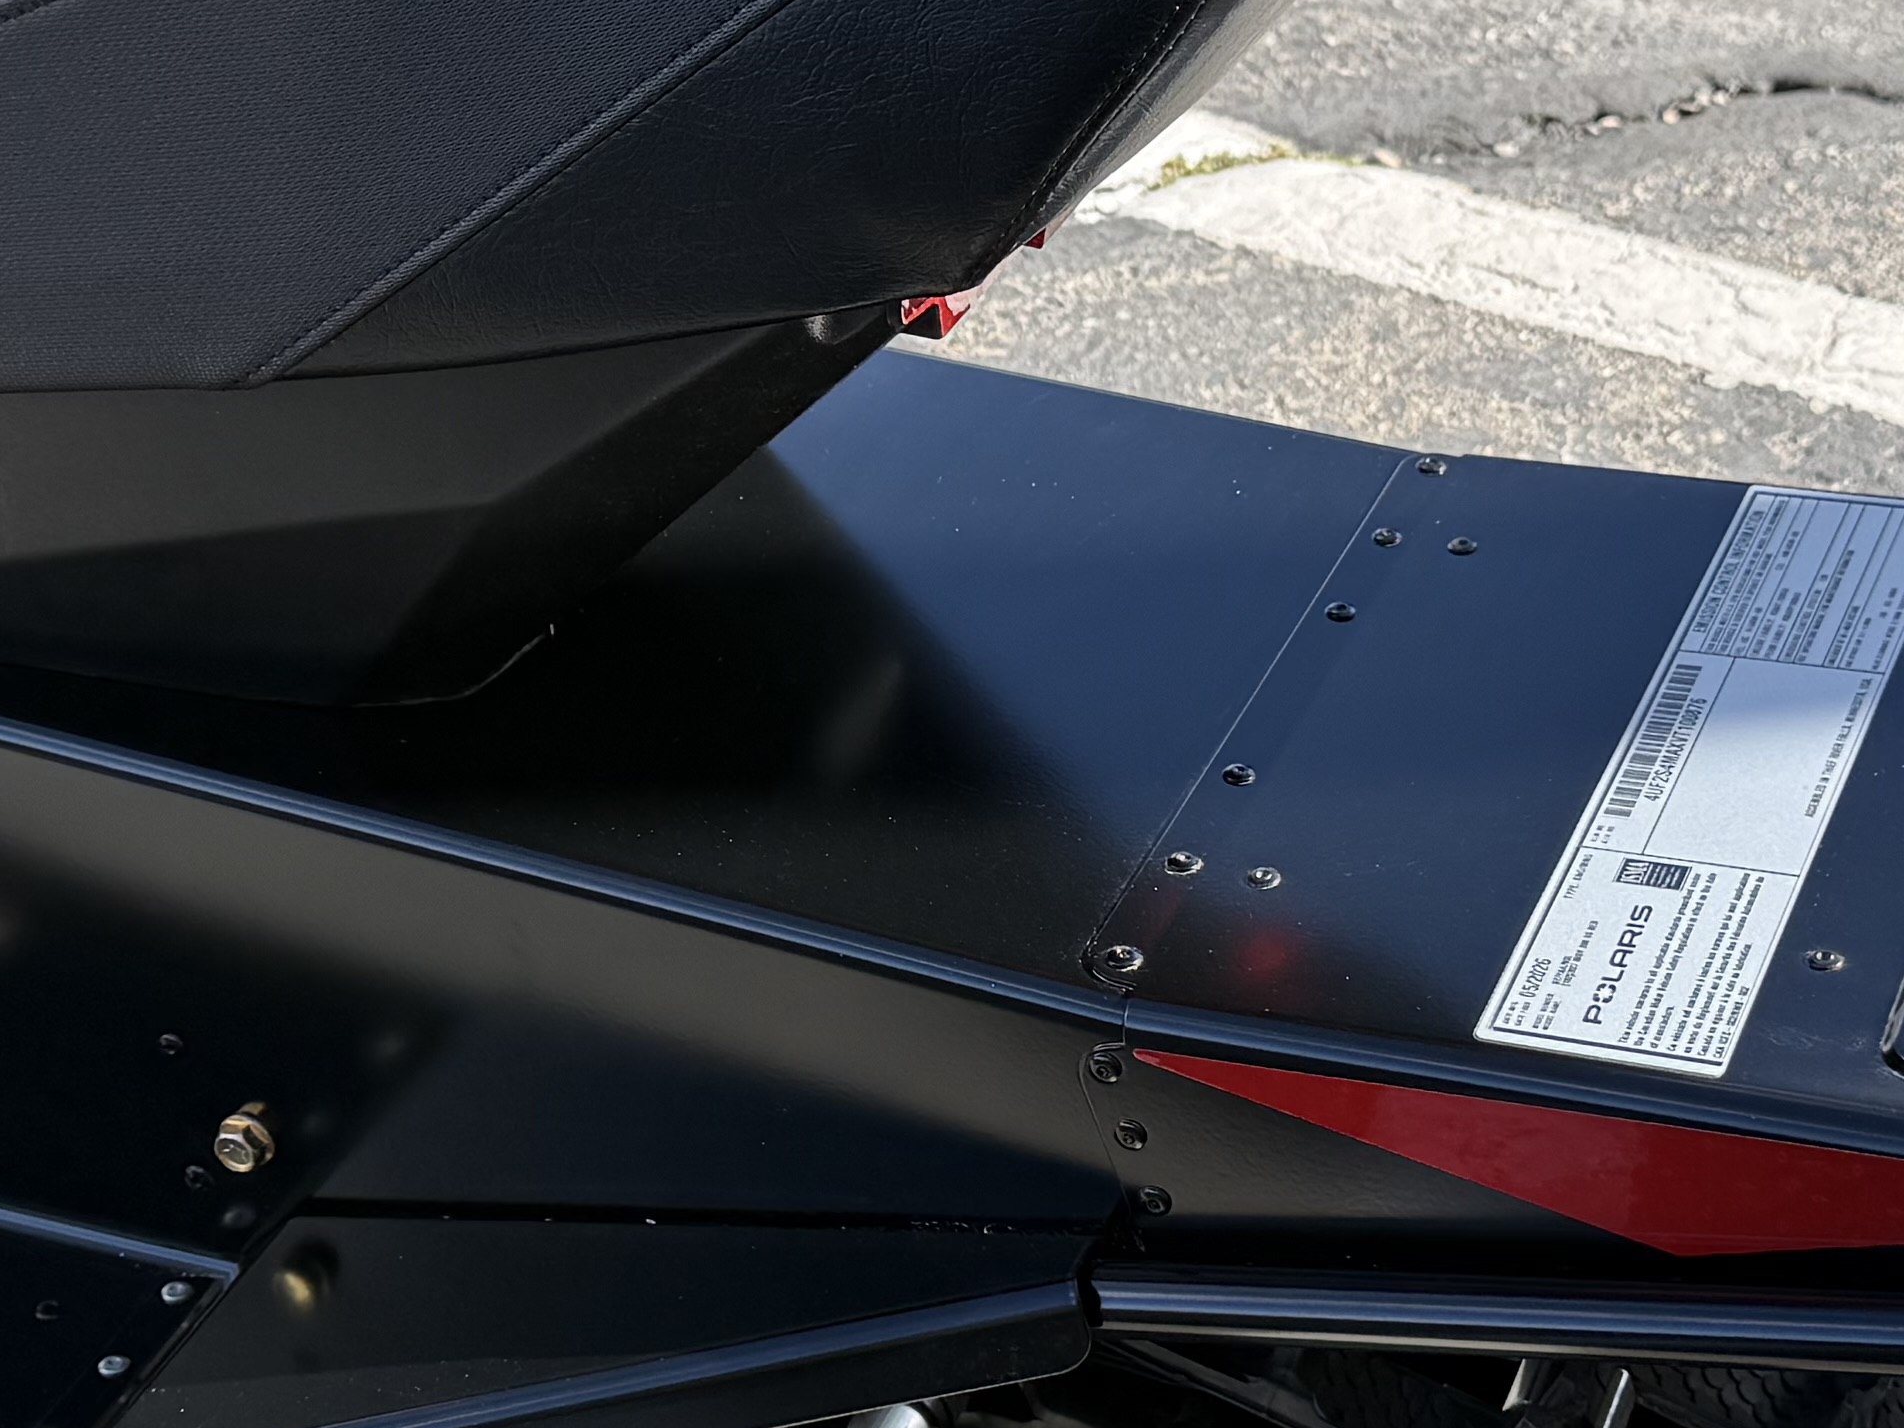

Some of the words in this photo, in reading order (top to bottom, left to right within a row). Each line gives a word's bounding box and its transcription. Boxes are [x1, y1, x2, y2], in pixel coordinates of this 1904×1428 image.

[1645, 697, 1707, 801] 4UF2S4MAXVT100876
[1519, 958, 1552, 998] 05/2026
[1583, 905, 1653, 1025] POLARIS
